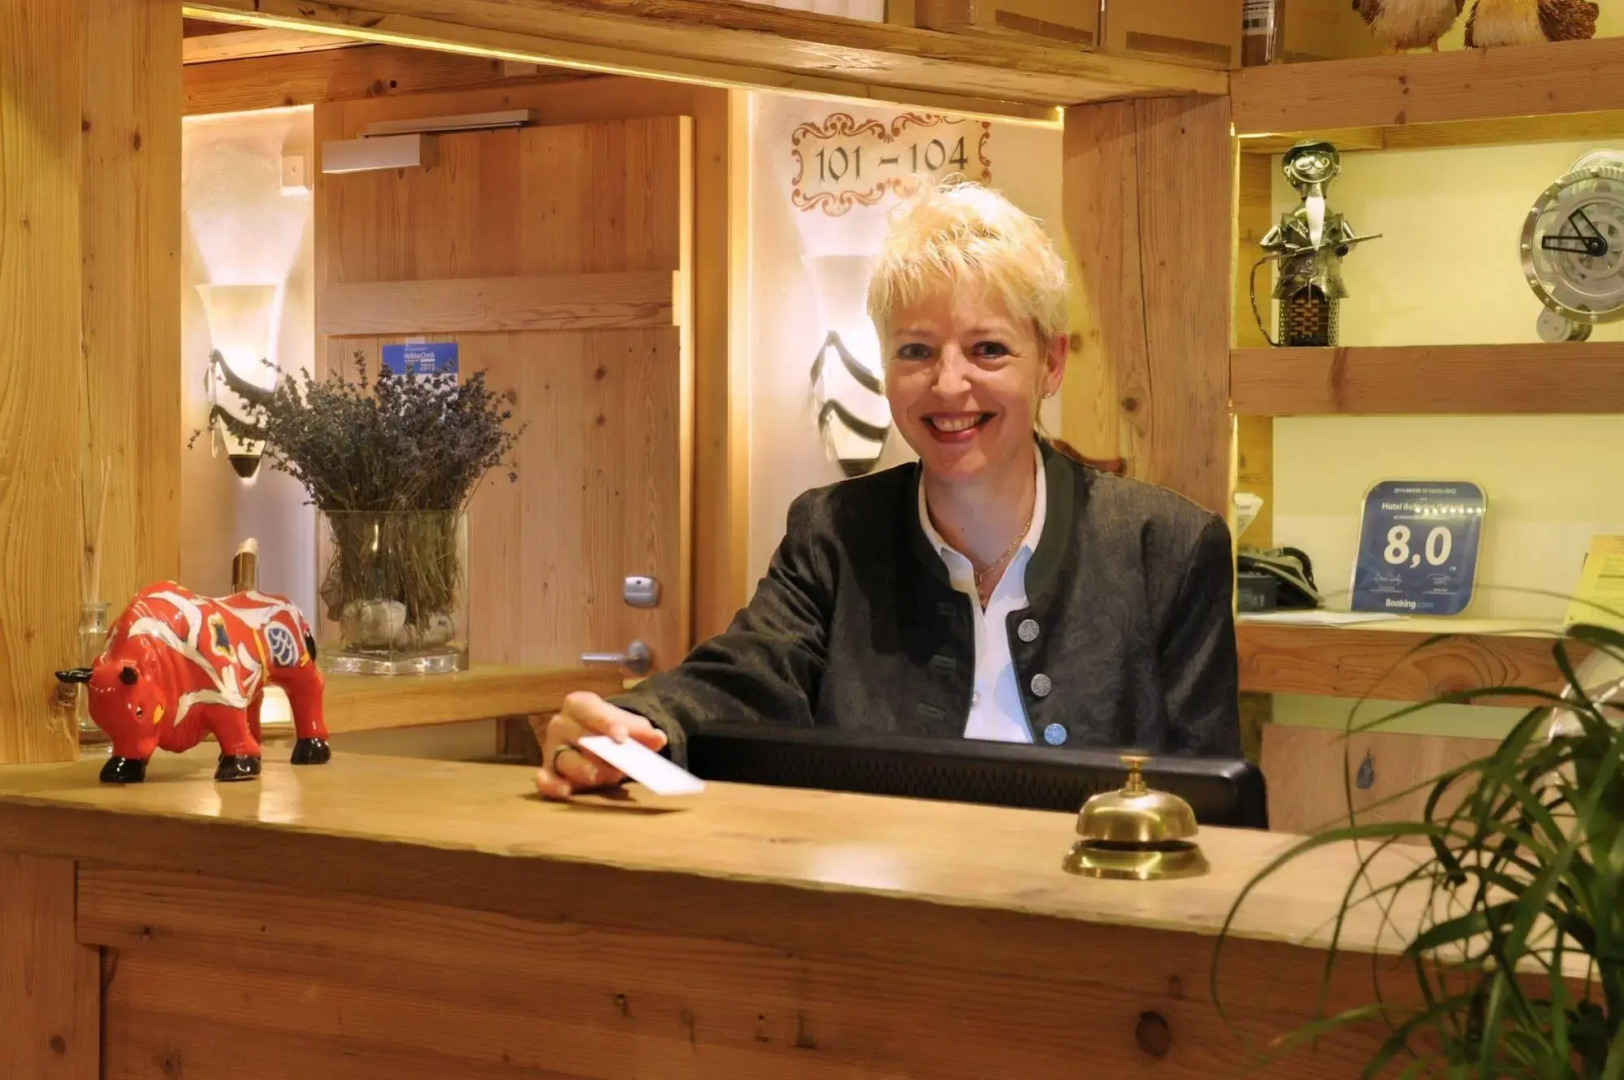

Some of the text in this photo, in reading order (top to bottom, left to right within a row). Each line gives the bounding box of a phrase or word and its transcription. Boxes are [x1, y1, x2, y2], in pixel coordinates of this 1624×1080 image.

[815, 145, 861, 184] 101
[909, 136, 969, 174] 104
[1381, 502, 1403, 510] Hotel
[1384, 525, 1452, 568] 8,0
